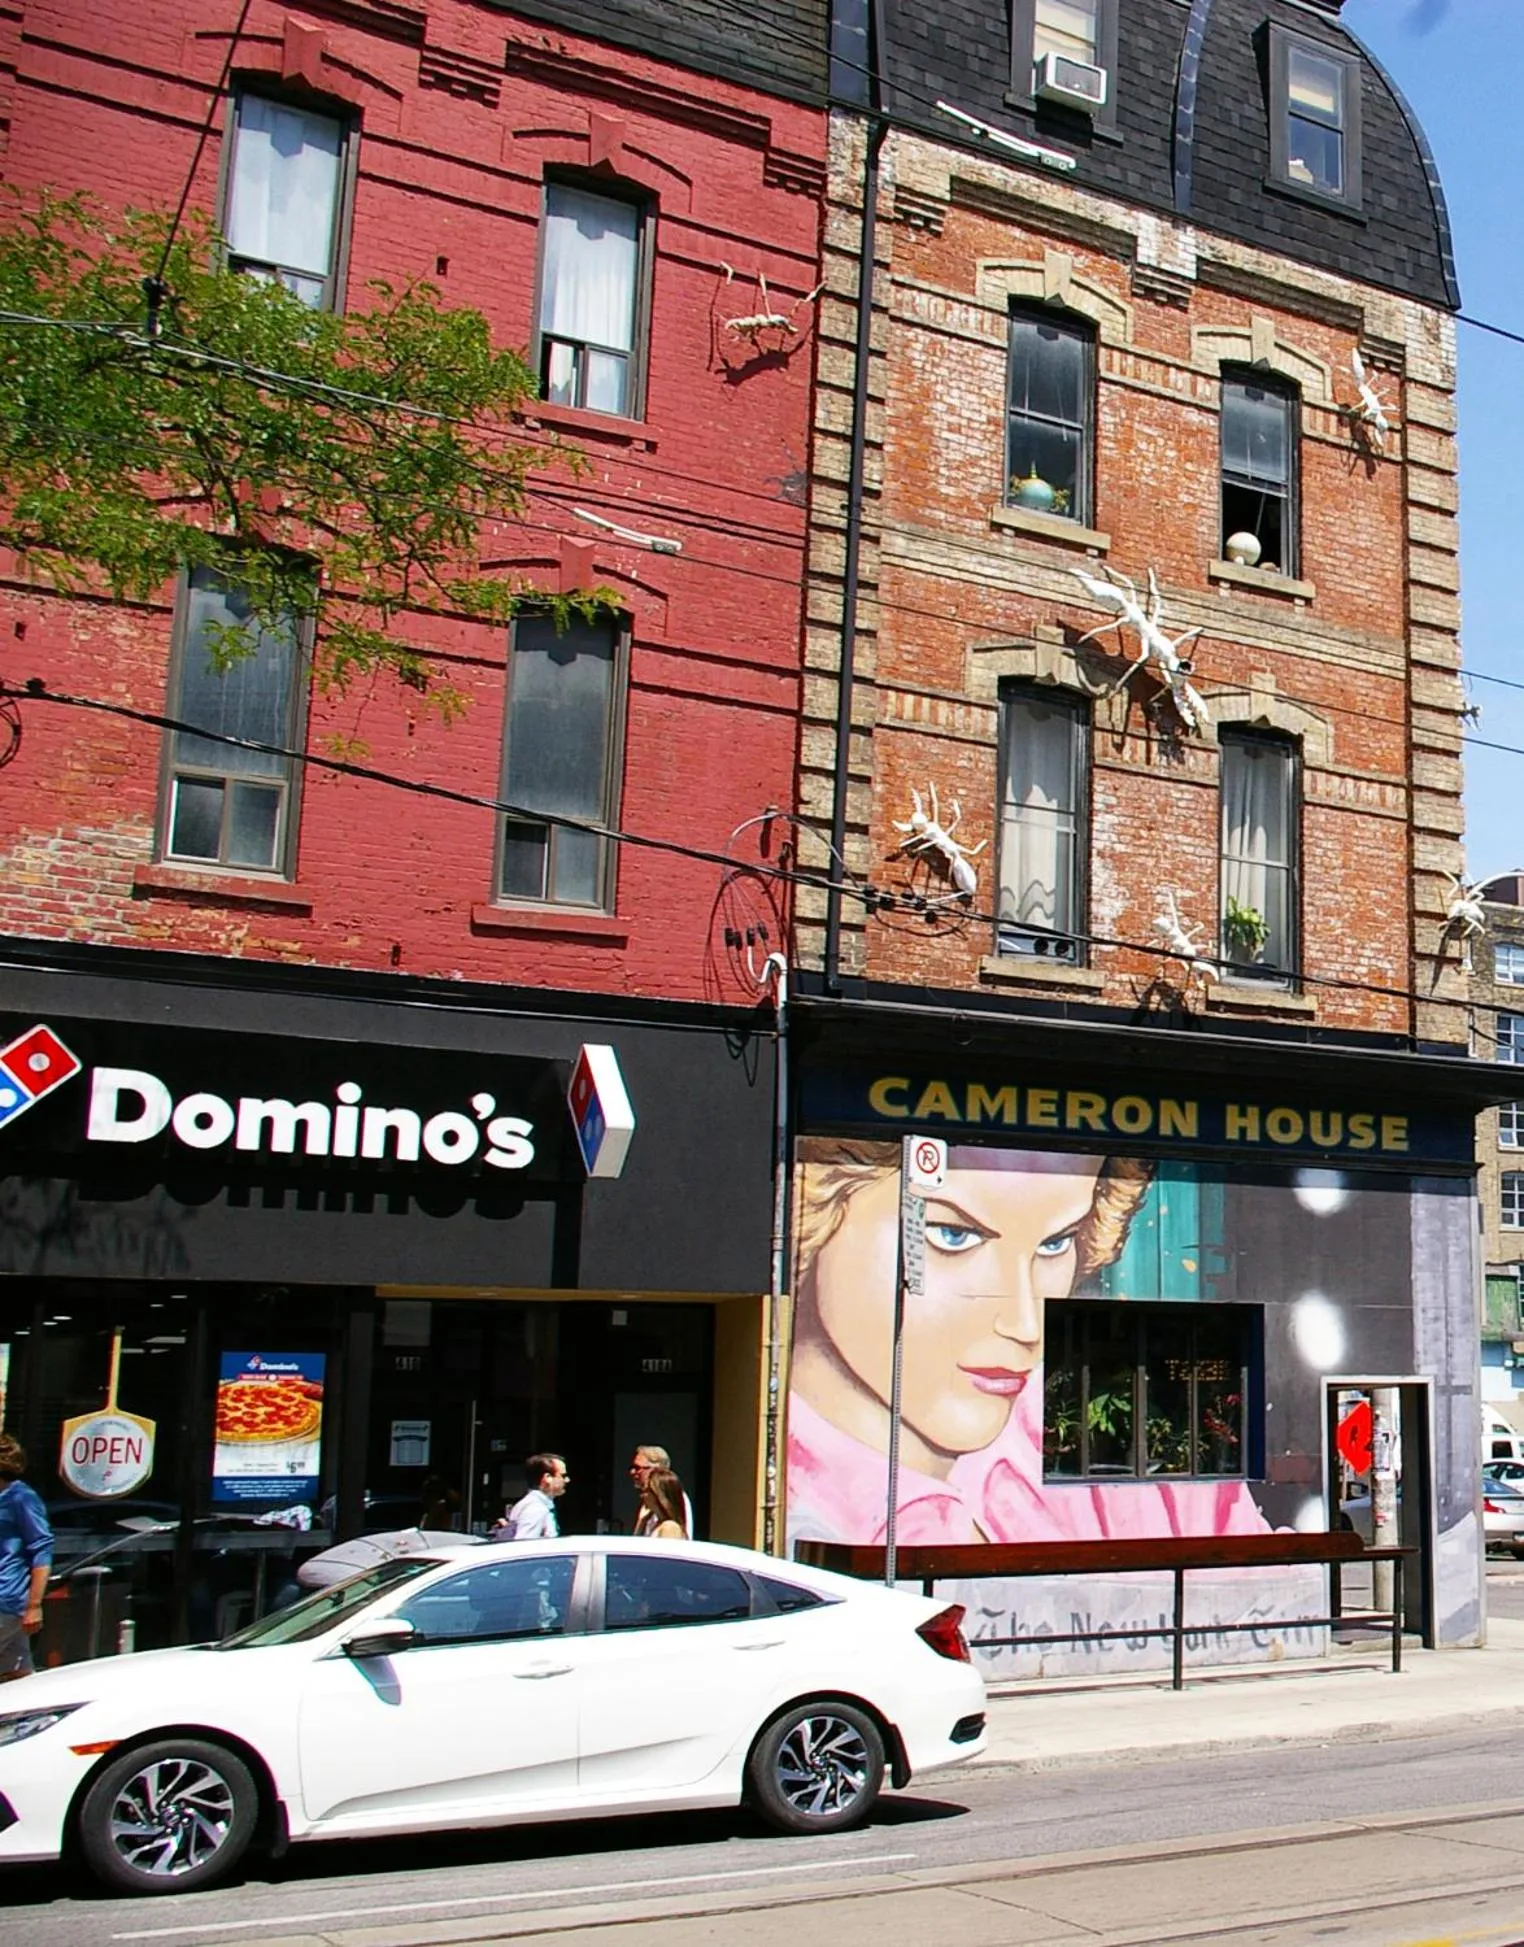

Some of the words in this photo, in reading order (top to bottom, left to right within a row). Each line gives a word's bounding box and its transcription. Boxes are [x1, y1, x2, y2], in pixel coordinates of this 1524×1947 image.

[86, 1066, 535, 1169] Domino's
[868, 1077, 1198, 1138] CAMERON
[1224, 1104, 1409, 1152] HOUSE
[71, 1436, 144, 1465] OPEN
[1069, 1611, 1149, 1654] New
